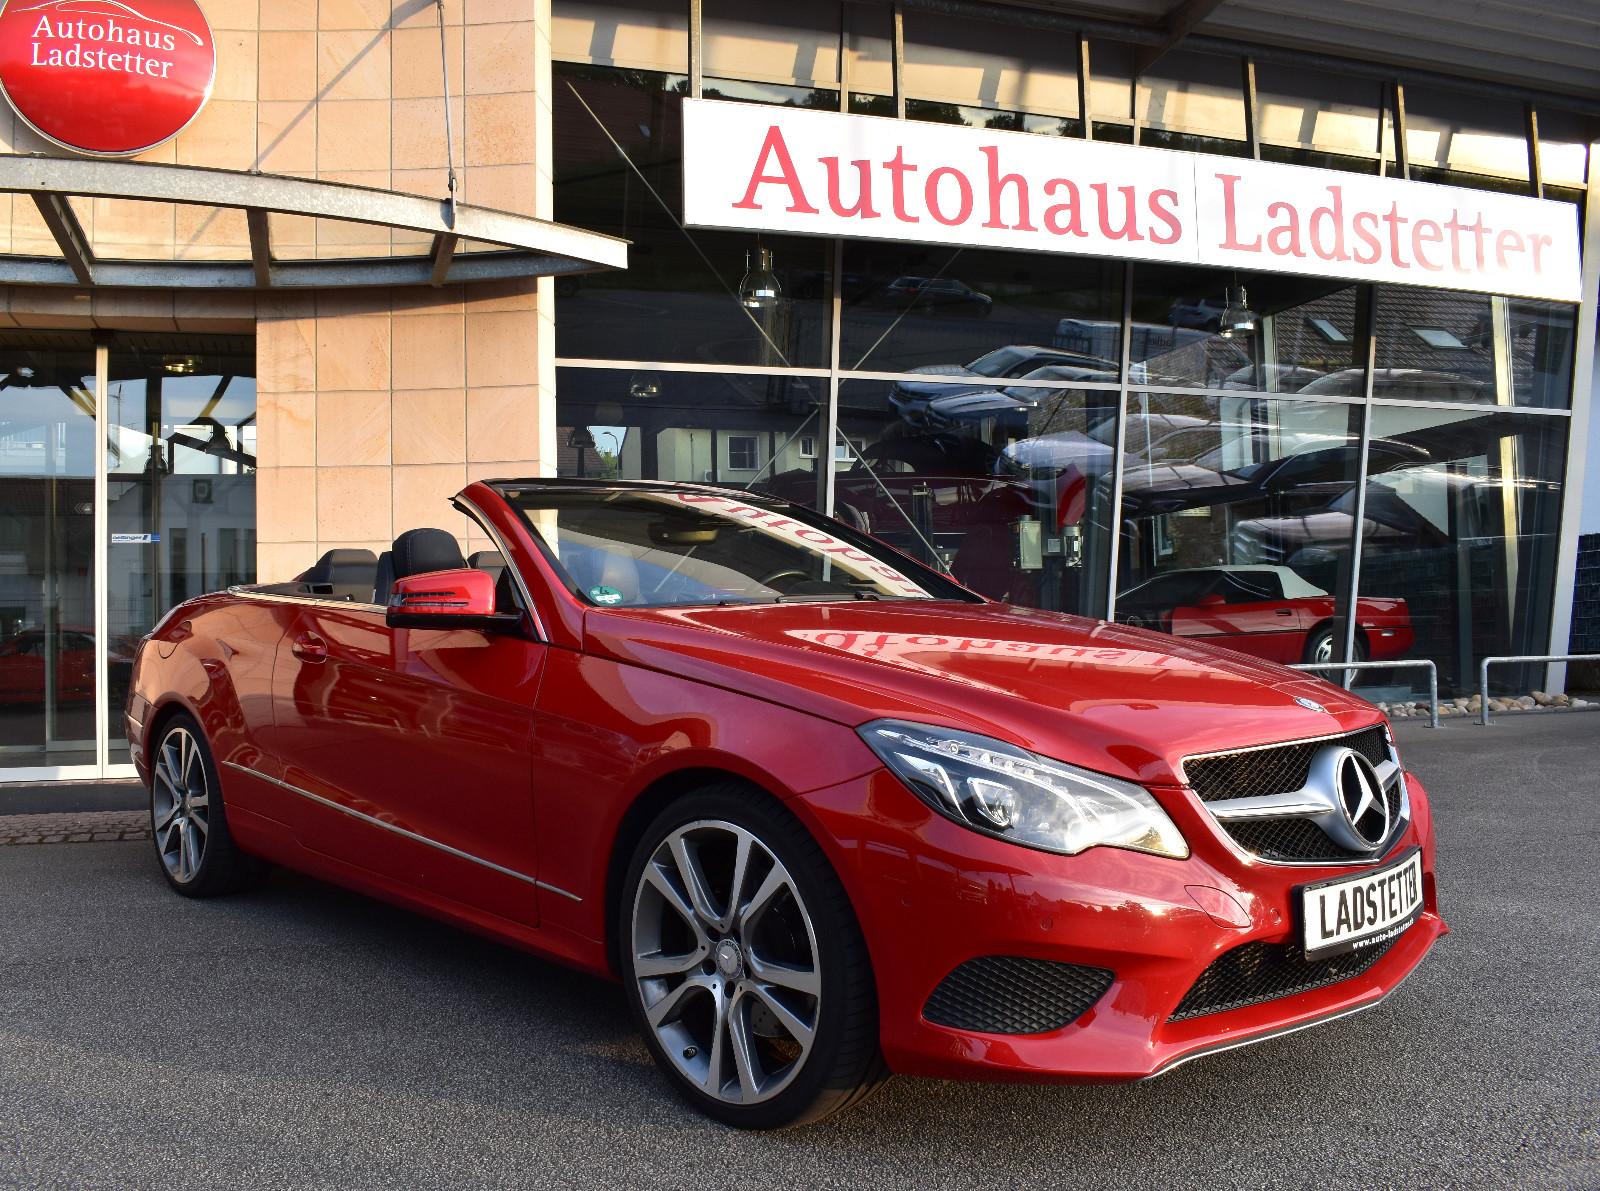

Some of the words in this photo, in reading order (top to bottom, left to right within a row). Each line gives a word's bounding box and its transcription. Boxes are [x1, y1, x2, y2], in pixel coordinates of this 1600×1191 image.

[31, 42, 174, 78] Ladstetter
[32, 15, 175, 51] Autohaus
[732, 125, 1183, 245] Autohaus
[1215, 173, 1552, 276] Ladstetter
[1319, 861, 1417, 940] LADSTETTER
